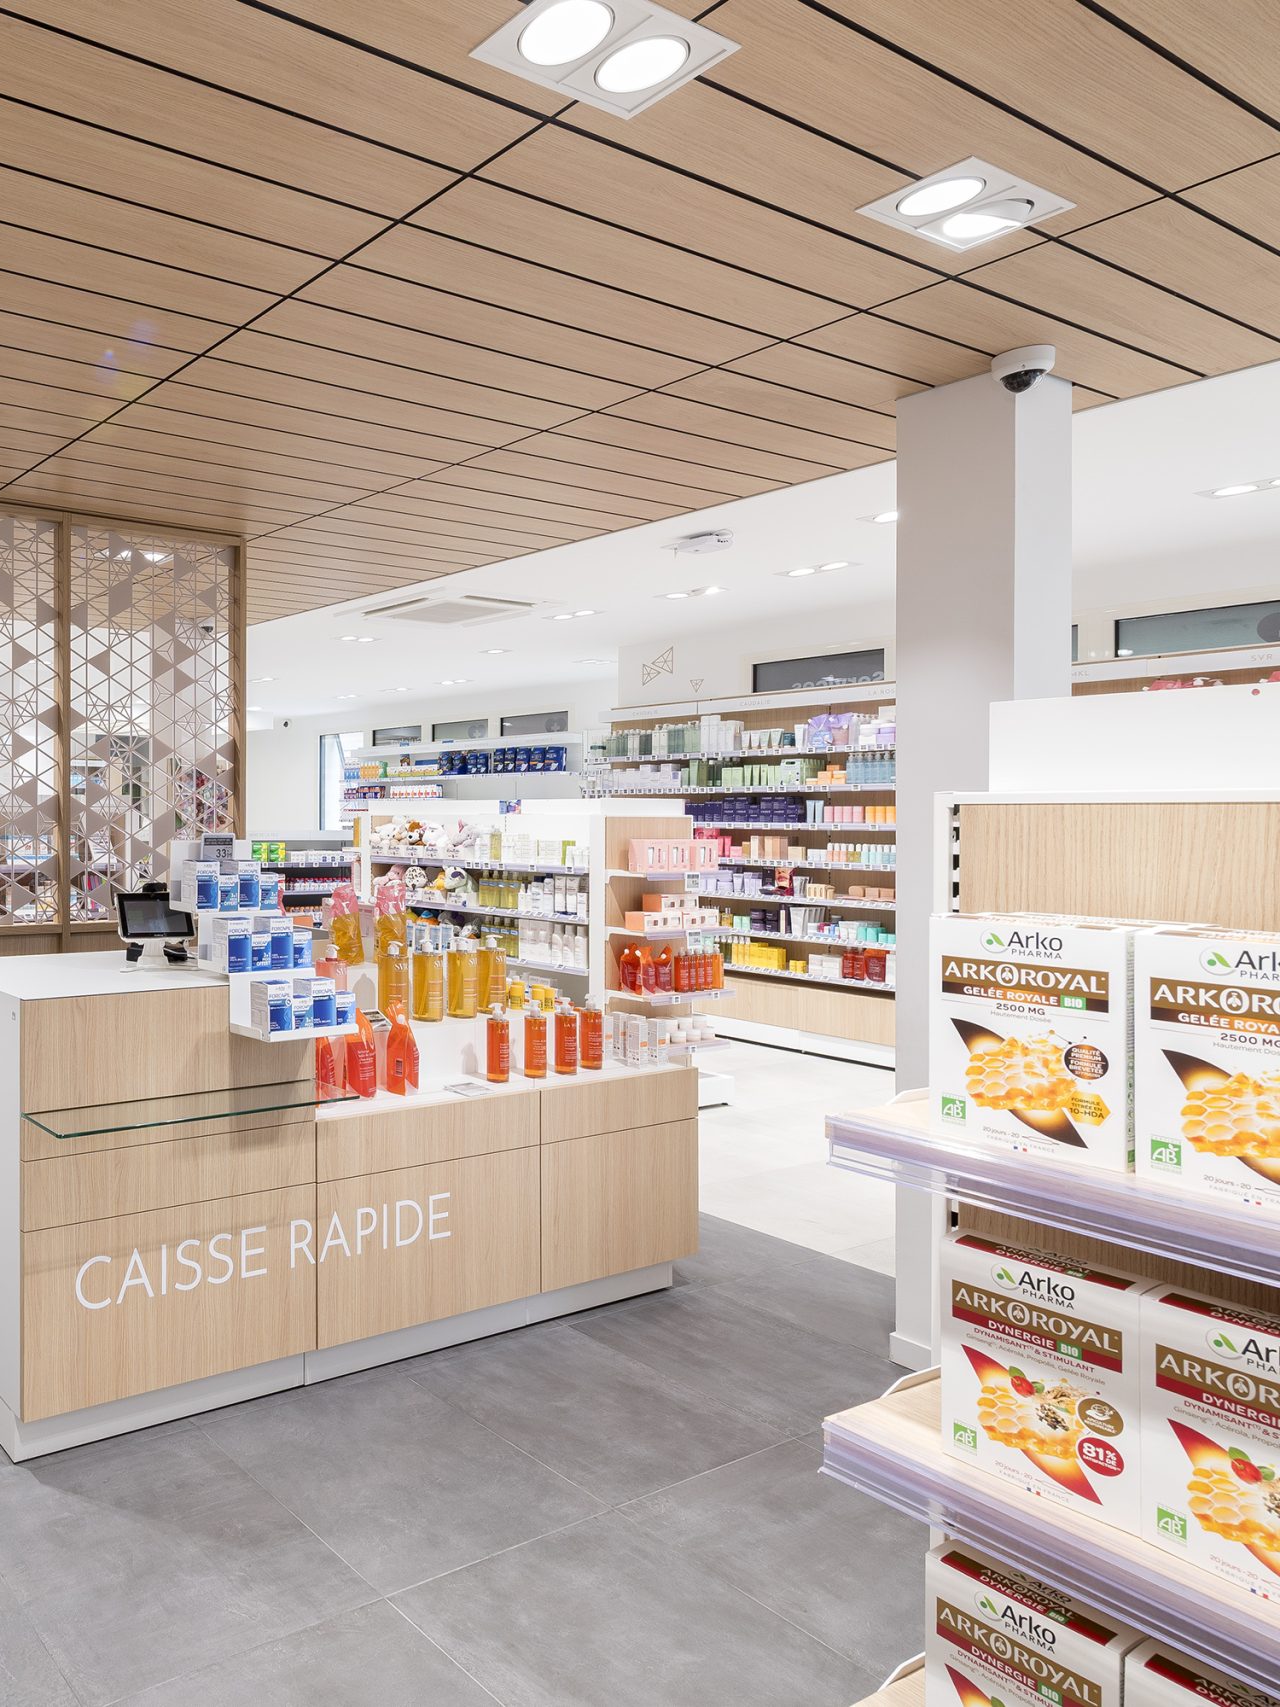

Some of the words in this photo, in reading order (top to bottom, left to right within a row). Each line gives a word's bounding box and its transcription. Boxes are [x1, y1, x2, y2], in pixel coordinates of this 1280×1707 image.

[1250, 653, 1272, 662] SVR
[1007, 931, 1063, 951] Arko
[1011, 948, 1063, 960] PHARMA
[944, 960, 1106, 994] ARKOROYAL
[963, 985, 1004, 999] GELÉE
[1006, 989, 1059, 1006] ROYALE
[1063, 997, 1083, 1009] BIO
[990, 1009, 1028, 1020] Hautement
[995, 1002, 1025, 1013] 2500
[1028, 1006, 1046, 1016] MG
[1177, 1012, 1231, 1028] GELÉE
[1212, 1042, 1262, 1053] Hautement
[1220, 1032, 1258, 1045] 2500
[942, 1102, 964, 1118] AB
[1069, 1107, 1105, 1120] 10-HDA
[1152, 1146, 1177, 1164] AB
[75, 1225, 268, 1310] CAISSE
[290, 1192, 452, 1269] RAPIDE
[995, 1249, 1064, 1272] DYNERGIE
[1019, 1271, 1075, 1301] Arko
[1023, 1288, 1075, 1310] PHARMA
[955, 1287, 1119, 1353] ARKOROYAL
[988, 1320, 1056, 1350] DYNERGIE
[1060, 1343, 1079, 1358] BIO
[1042, 1350, 1095, 1374] STIMULANT
[1241, 1338, 1280, 1365] Ar
[1080, 1371, 1106, 1386] Royale
[954, 1430, 975, 1447] AB
[1158, 1515, 1184, 1537] AB
[979, 1575, 1047, 1612] DYNERGIE
[980, 1568, 1076, 1620] ARKOROYAL
[1001, 1605, 1057, 1645] Arko
[1004, 1621, 1056, 1655] PHARMA
[939, 1607, 1099, 1706] ARKOROYAL
[971, 1645, 1037, 1690] DYNERGIE
[1041, 1684, 1059, 1702] BIO
